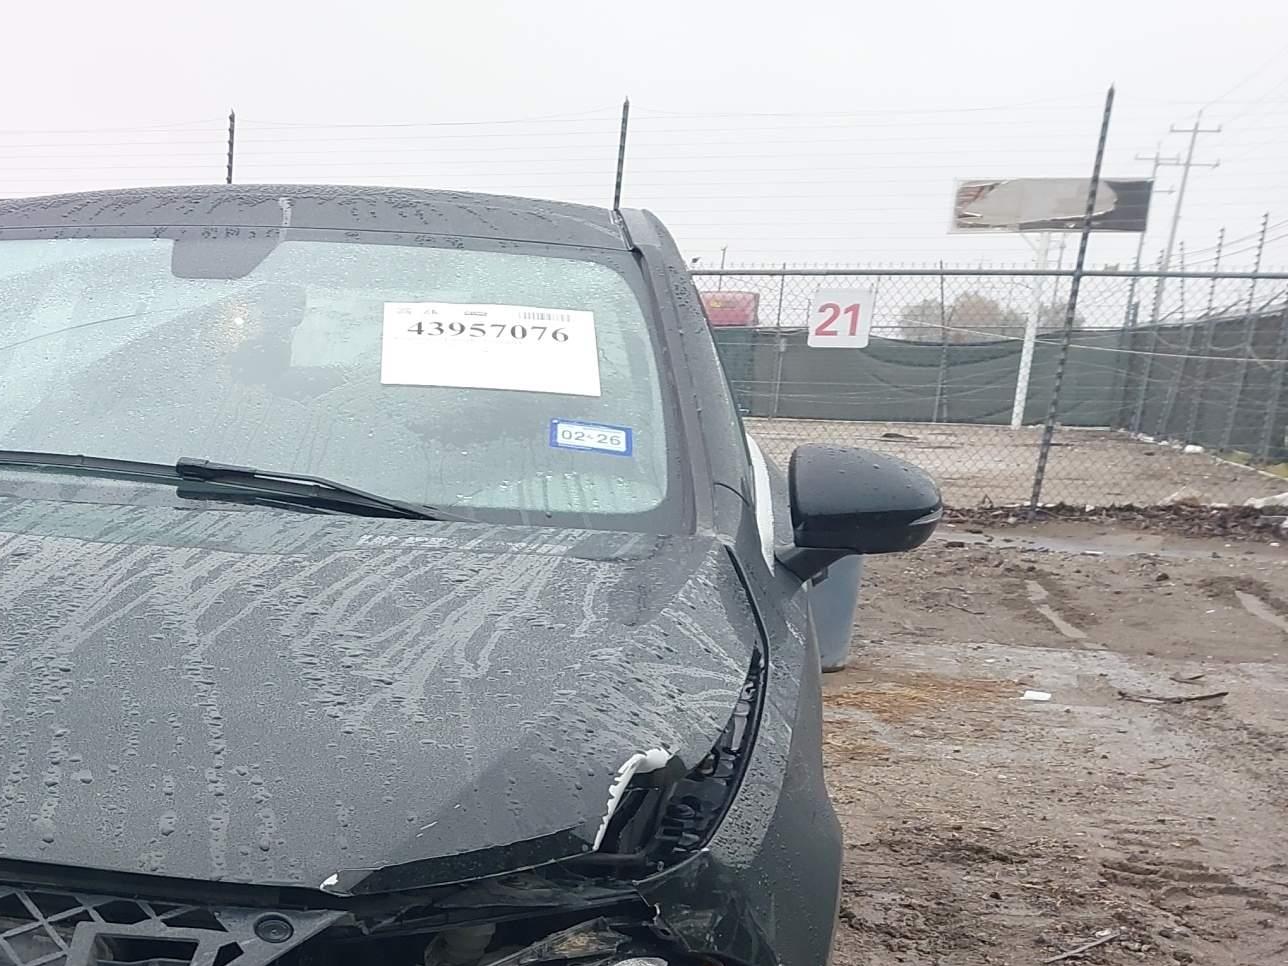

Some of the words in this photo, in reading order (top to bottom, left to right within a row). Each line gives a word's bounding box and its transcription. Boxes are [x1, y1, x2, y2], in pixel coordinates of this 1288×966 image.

[406, 320, 570, 343] 43957076
[814, 303, 861, 337] 21
[560, 428, 622, 447] 02-26
